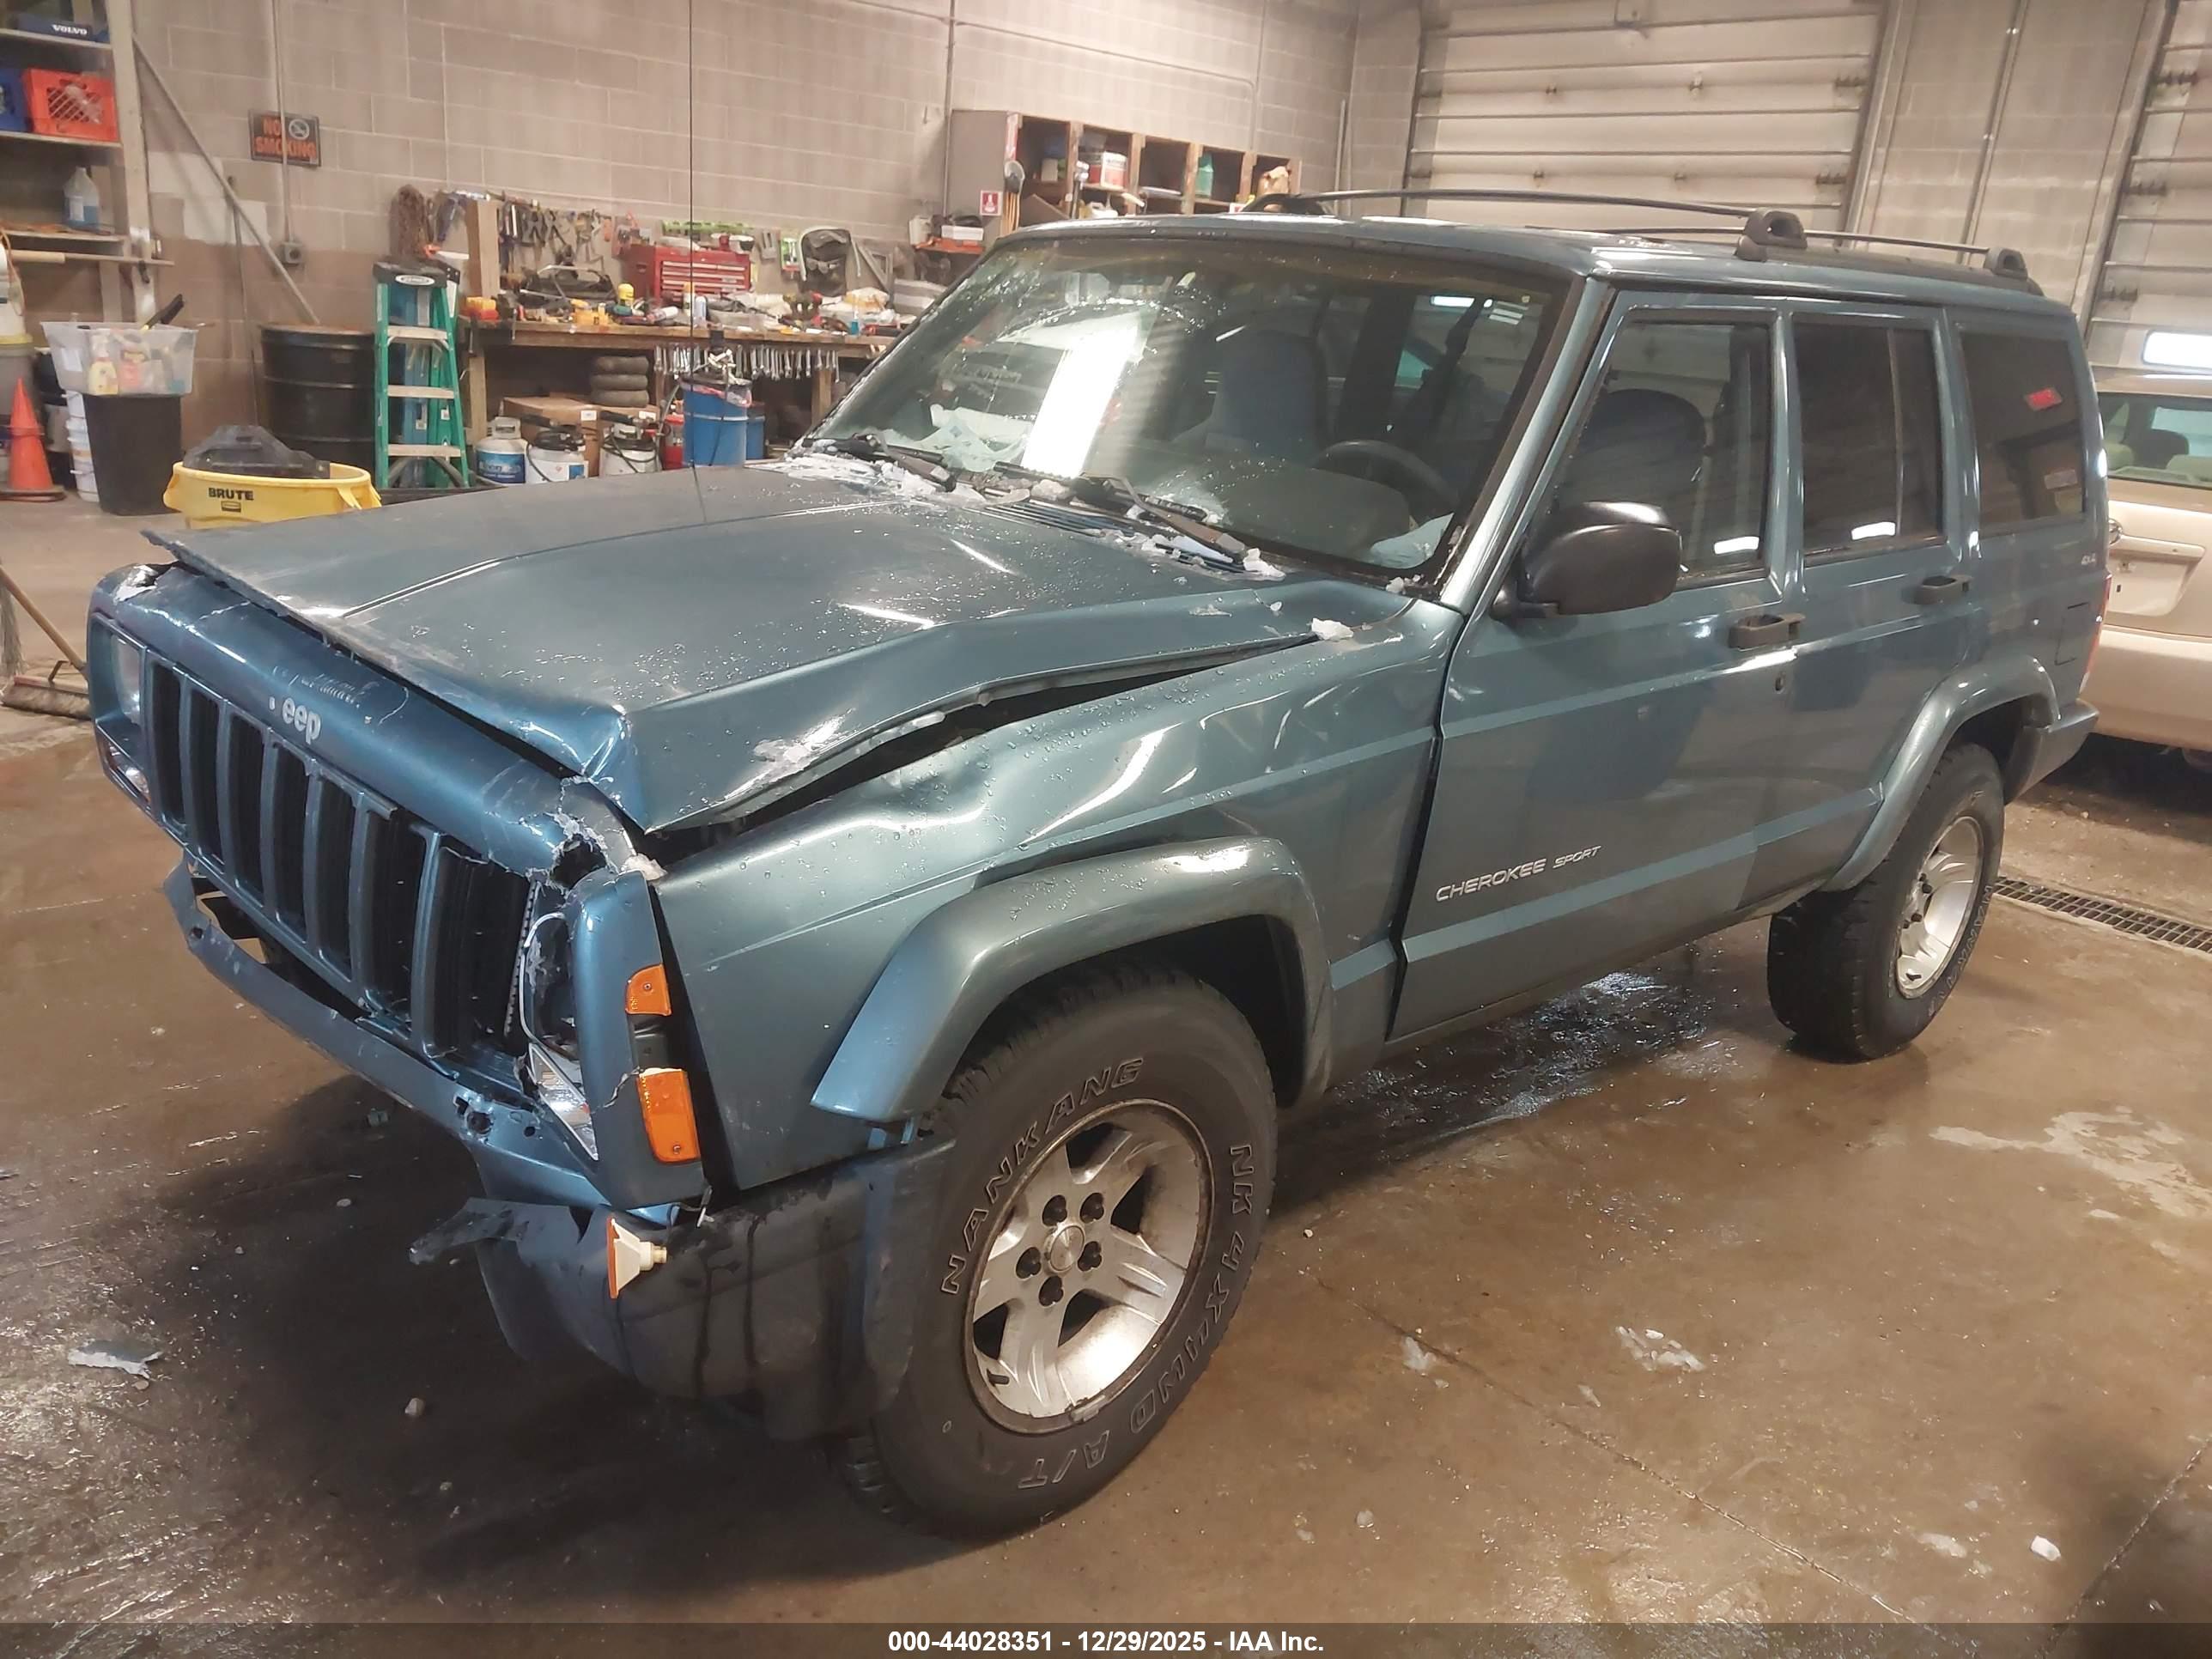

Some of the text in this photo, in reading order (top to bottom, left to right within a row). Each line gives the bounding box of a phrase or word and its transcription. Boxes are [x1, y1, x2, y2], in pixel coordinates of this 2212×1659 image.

[52, 24, 88, 35] VOLVO
[255, 137, 317, 158] SMOKING
[263, 117, 282, 136] NO
[209, 487, 254, 501] BRUTE
[269, 696, 322, 745] eep
[1436, 845, 1601, 902] CHEROKEE SPORT
[941, 1057, 1144, 1294] NANKANG
[1230, 1144, 1255, 1215] NK
[1018, 1429, 1110, 1489] A/T
